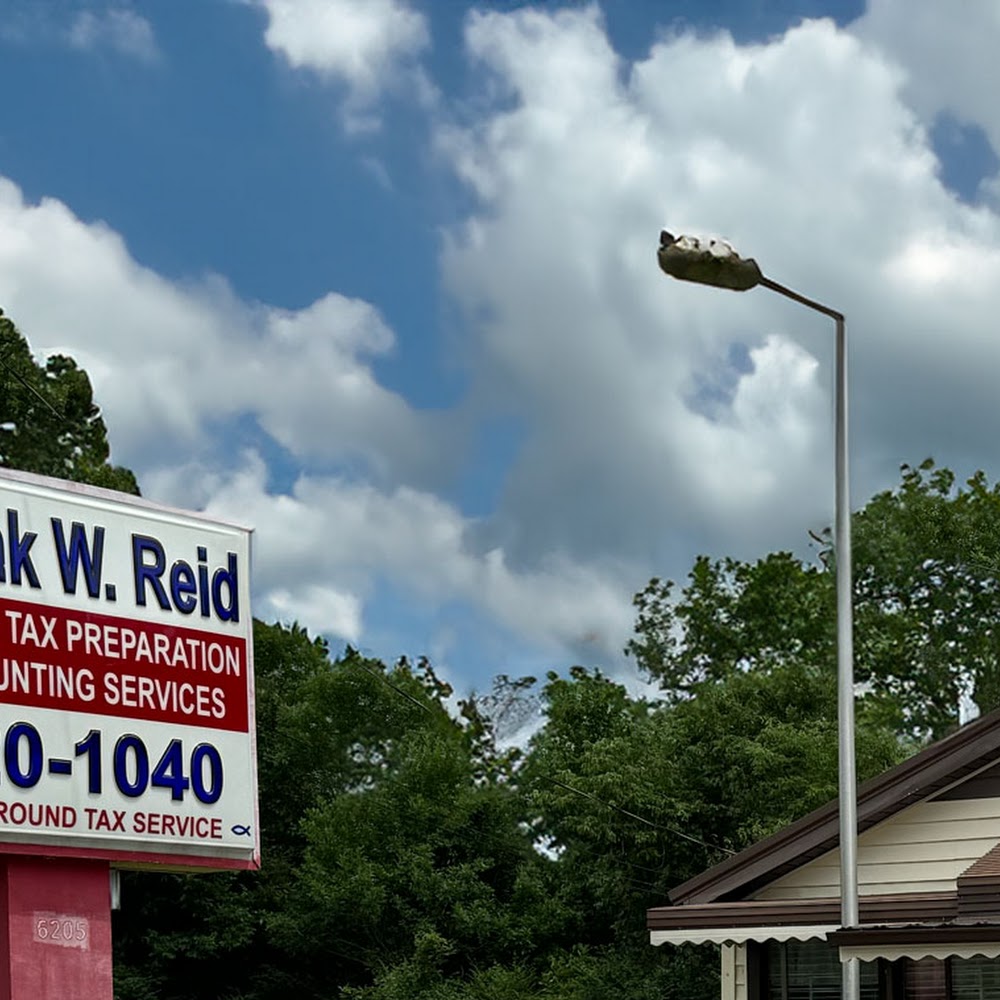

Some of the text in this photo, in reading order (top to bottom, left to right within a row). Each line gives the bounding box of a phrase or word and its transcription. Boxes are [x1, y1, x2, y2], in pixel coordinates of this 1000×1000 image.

[50, 517, 117, 601] W.
[131, 533, 240, 623] Reid
[5, 610, 240, 677] TAX PREPARATION
[103, 672, 226, 719] SERVICES
[84, 808, 126, 832] TAX
[133, 812, 223, 839] SERVICE
[37, 919, 86, 941] 6205
